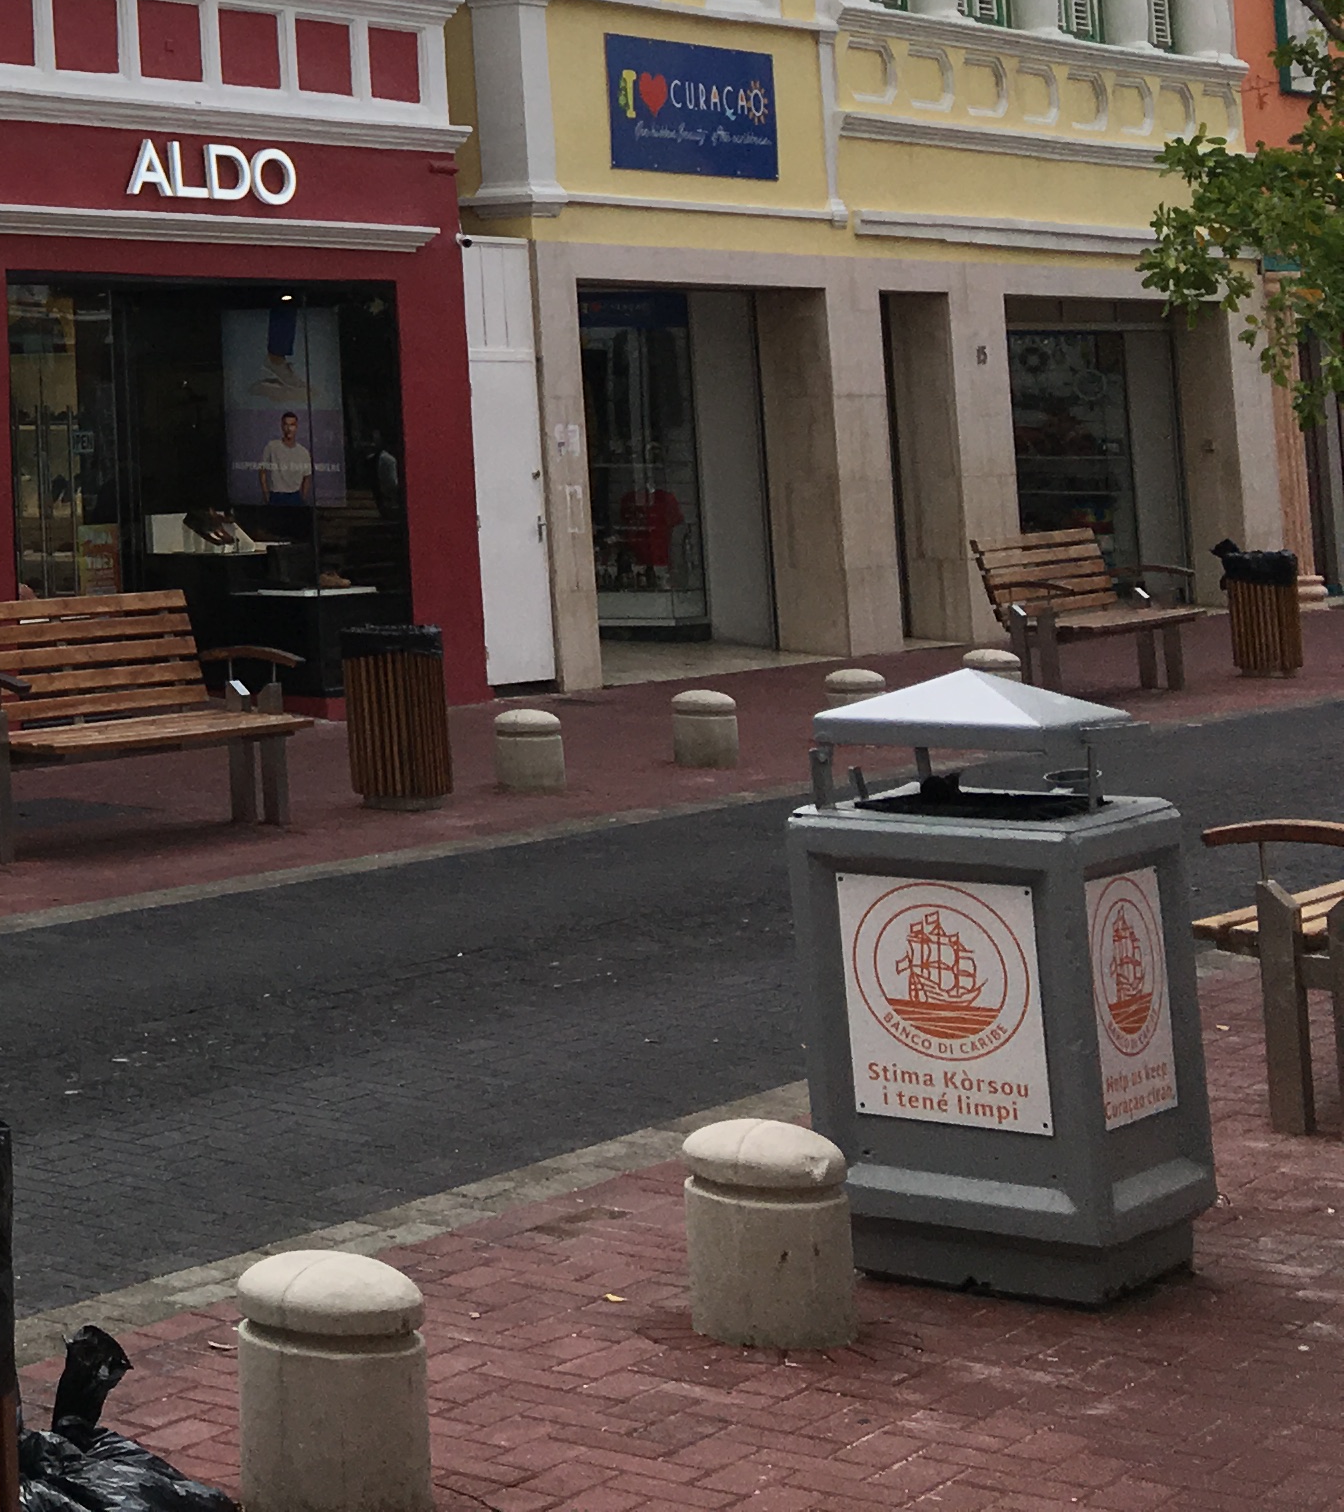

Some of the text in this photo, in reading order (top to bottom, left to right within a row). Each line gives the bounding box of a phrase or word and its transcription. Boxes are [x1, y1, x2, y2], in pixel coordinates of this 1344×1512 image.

[126, 138, 297, 206] ALDO
[883, 1011, 1009, 1055] BANCO DI CARIBE
[868, 1062, 1029, 1099] Stima Kòrsou
[1106, 1062, 1167, 1093] Help us keep
[882, 1087, 1019, 1123] i tené limpi
[1105, 1085, 1172, 1120] Curaçao clean
